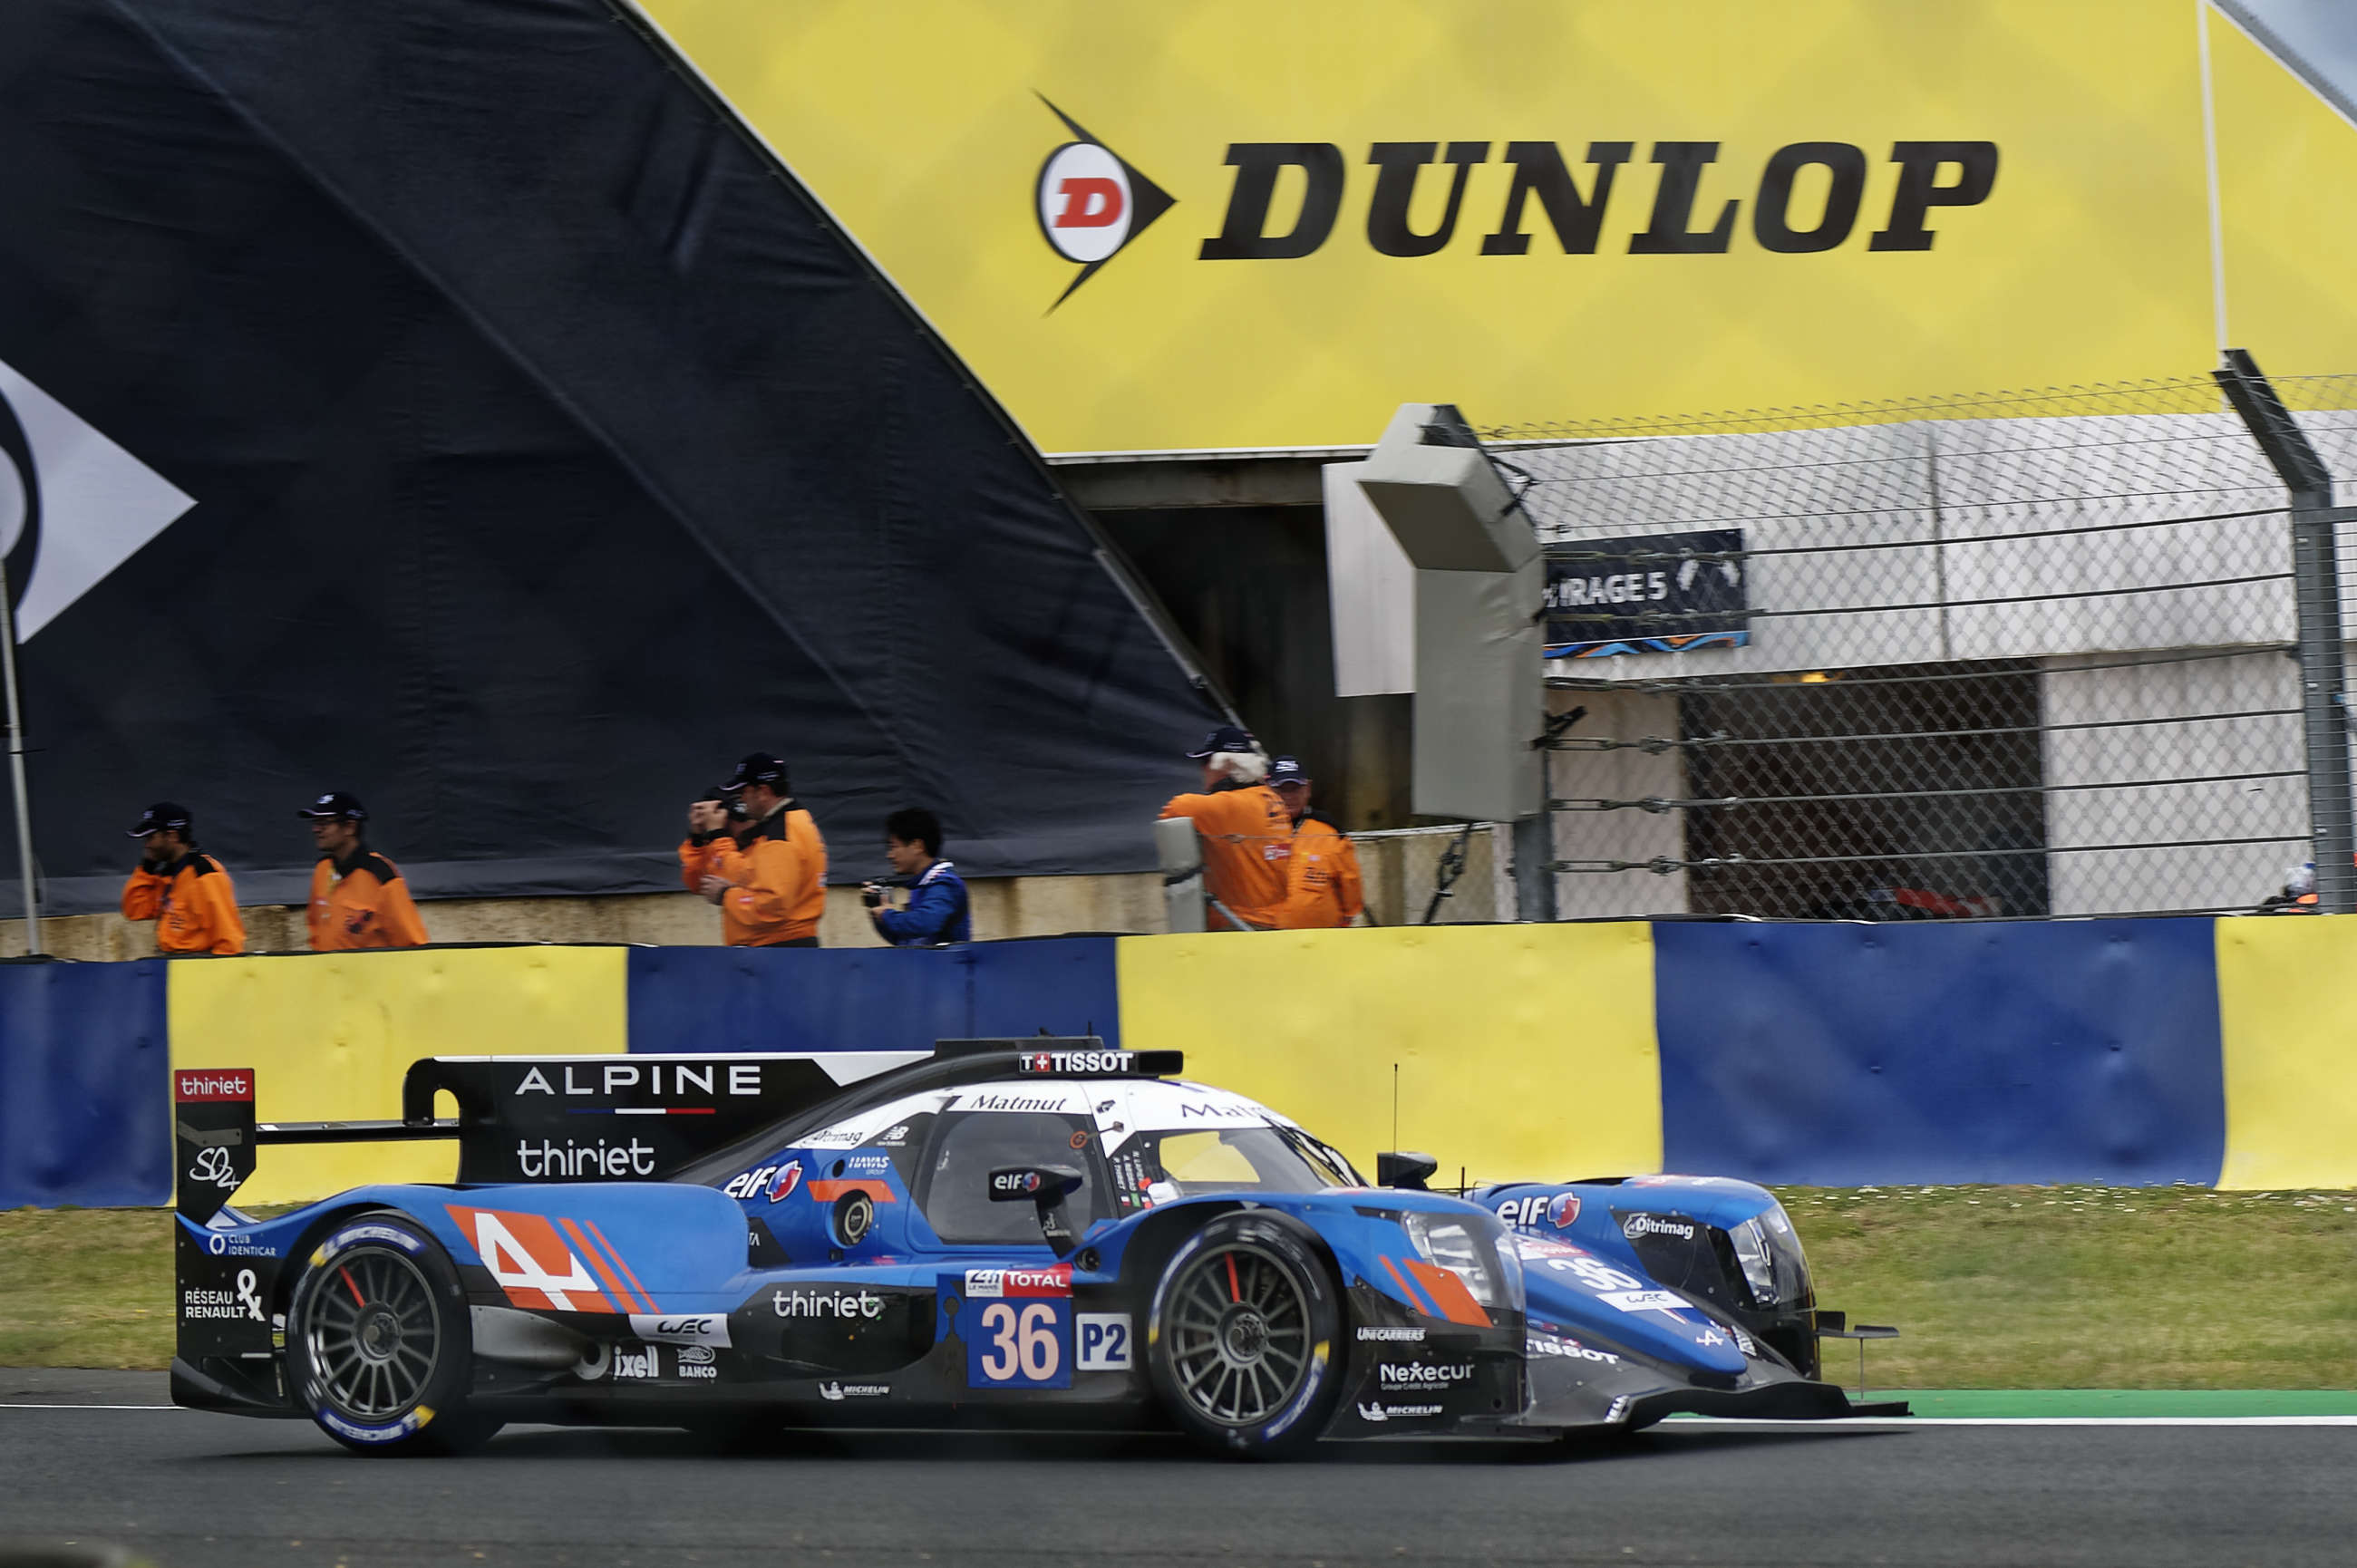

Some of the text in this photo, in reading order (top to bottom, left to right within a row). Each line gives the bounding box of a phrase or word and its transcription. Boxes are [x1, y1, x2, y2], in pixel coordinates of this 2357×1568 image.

[1198, 140, 2000, 260] DUNLOP
[1051, 1052, 1134, 1072] TISSOT
[181, 1076, 247, 1095] thiriet
[515, 1066, 761, 1095] ALPINE
[971, 1095, 1067, 1111] Matmut
[517, 1137, 655, 1177] thiriet
[849, 1156, 890, 1168] HAVAS
[723, 1166, 775, 1198] elf
[994, 1173, 1023, 1190] elf
[1496, 1195, 1549, 1226] elf
[228, 1234, 250, 1244] CLUB
[228, 1246, 276, 1256] IDENTICAR
[1006, 1271, 1067, 1287] TOTAL
[1547, 1257, 1643, 1291] 36
[185, 1287, 234, 1305] RÉSEAU
[772, 1290, 880, 1318] thiriet
[185, 1306, 247, 1319] RENAULT
[657, 1318, 713, 1335] WEC
[981, 1302, 1060, 1381] 36
[1082, 1323, 1127, 1362] P2
[614, 1345, 660, 1379] ixell
[1380, 1360, 1476, 1383] Nexecur
[843, 1384, 890, 1395] MICHELIN
[1386, 1404, 1444, 1415] MICHELIN
